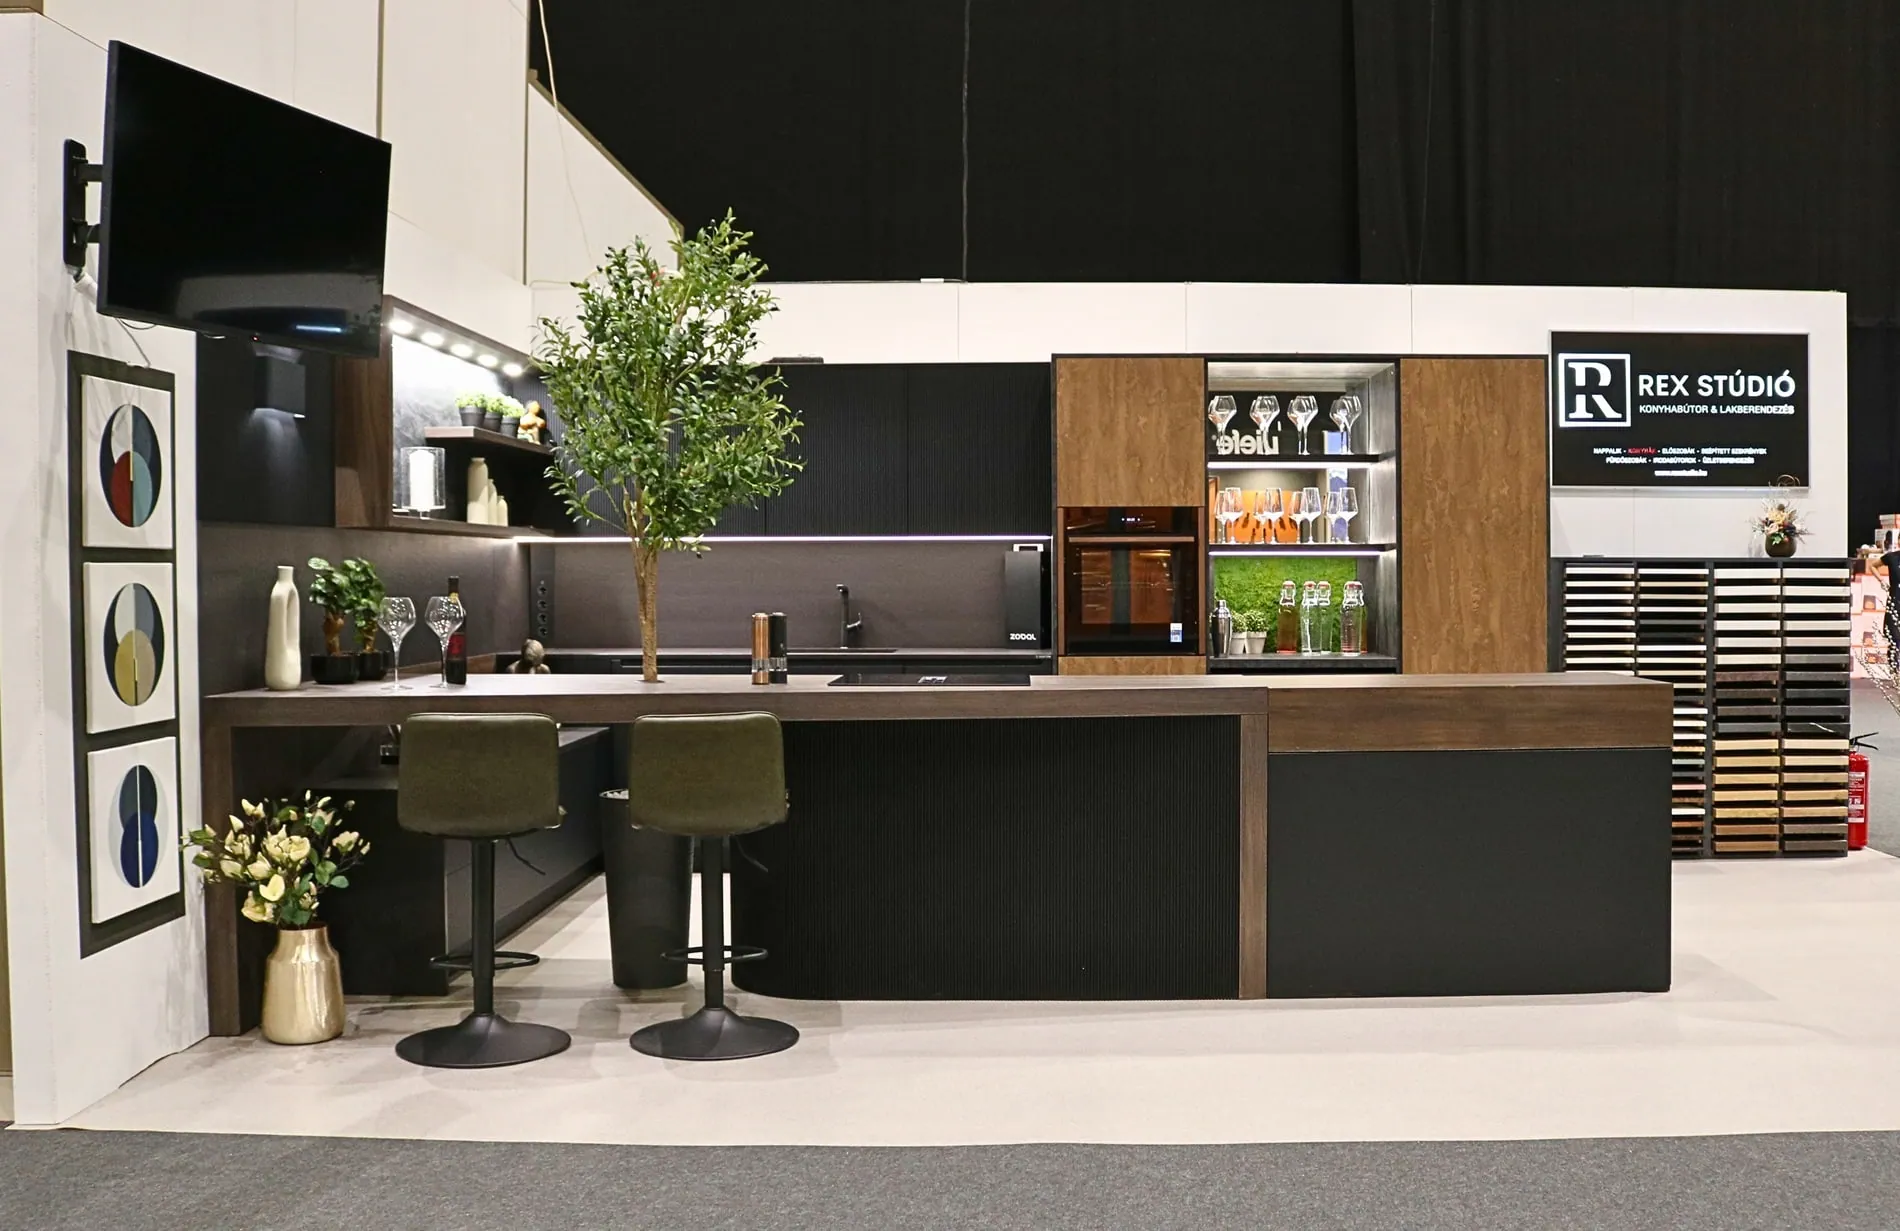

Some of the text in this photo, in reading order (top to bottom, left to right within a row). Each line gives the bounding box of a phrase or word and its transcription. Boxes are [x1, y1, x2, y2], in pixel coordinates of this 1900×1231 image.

[1567, 361, 1623, 419] R
[1638, 368, 1796, 398] REX STÚDIÓ
[1639, 403, 1795, 415] KONYHABÚTOR & LAKBERENDEZÉS
